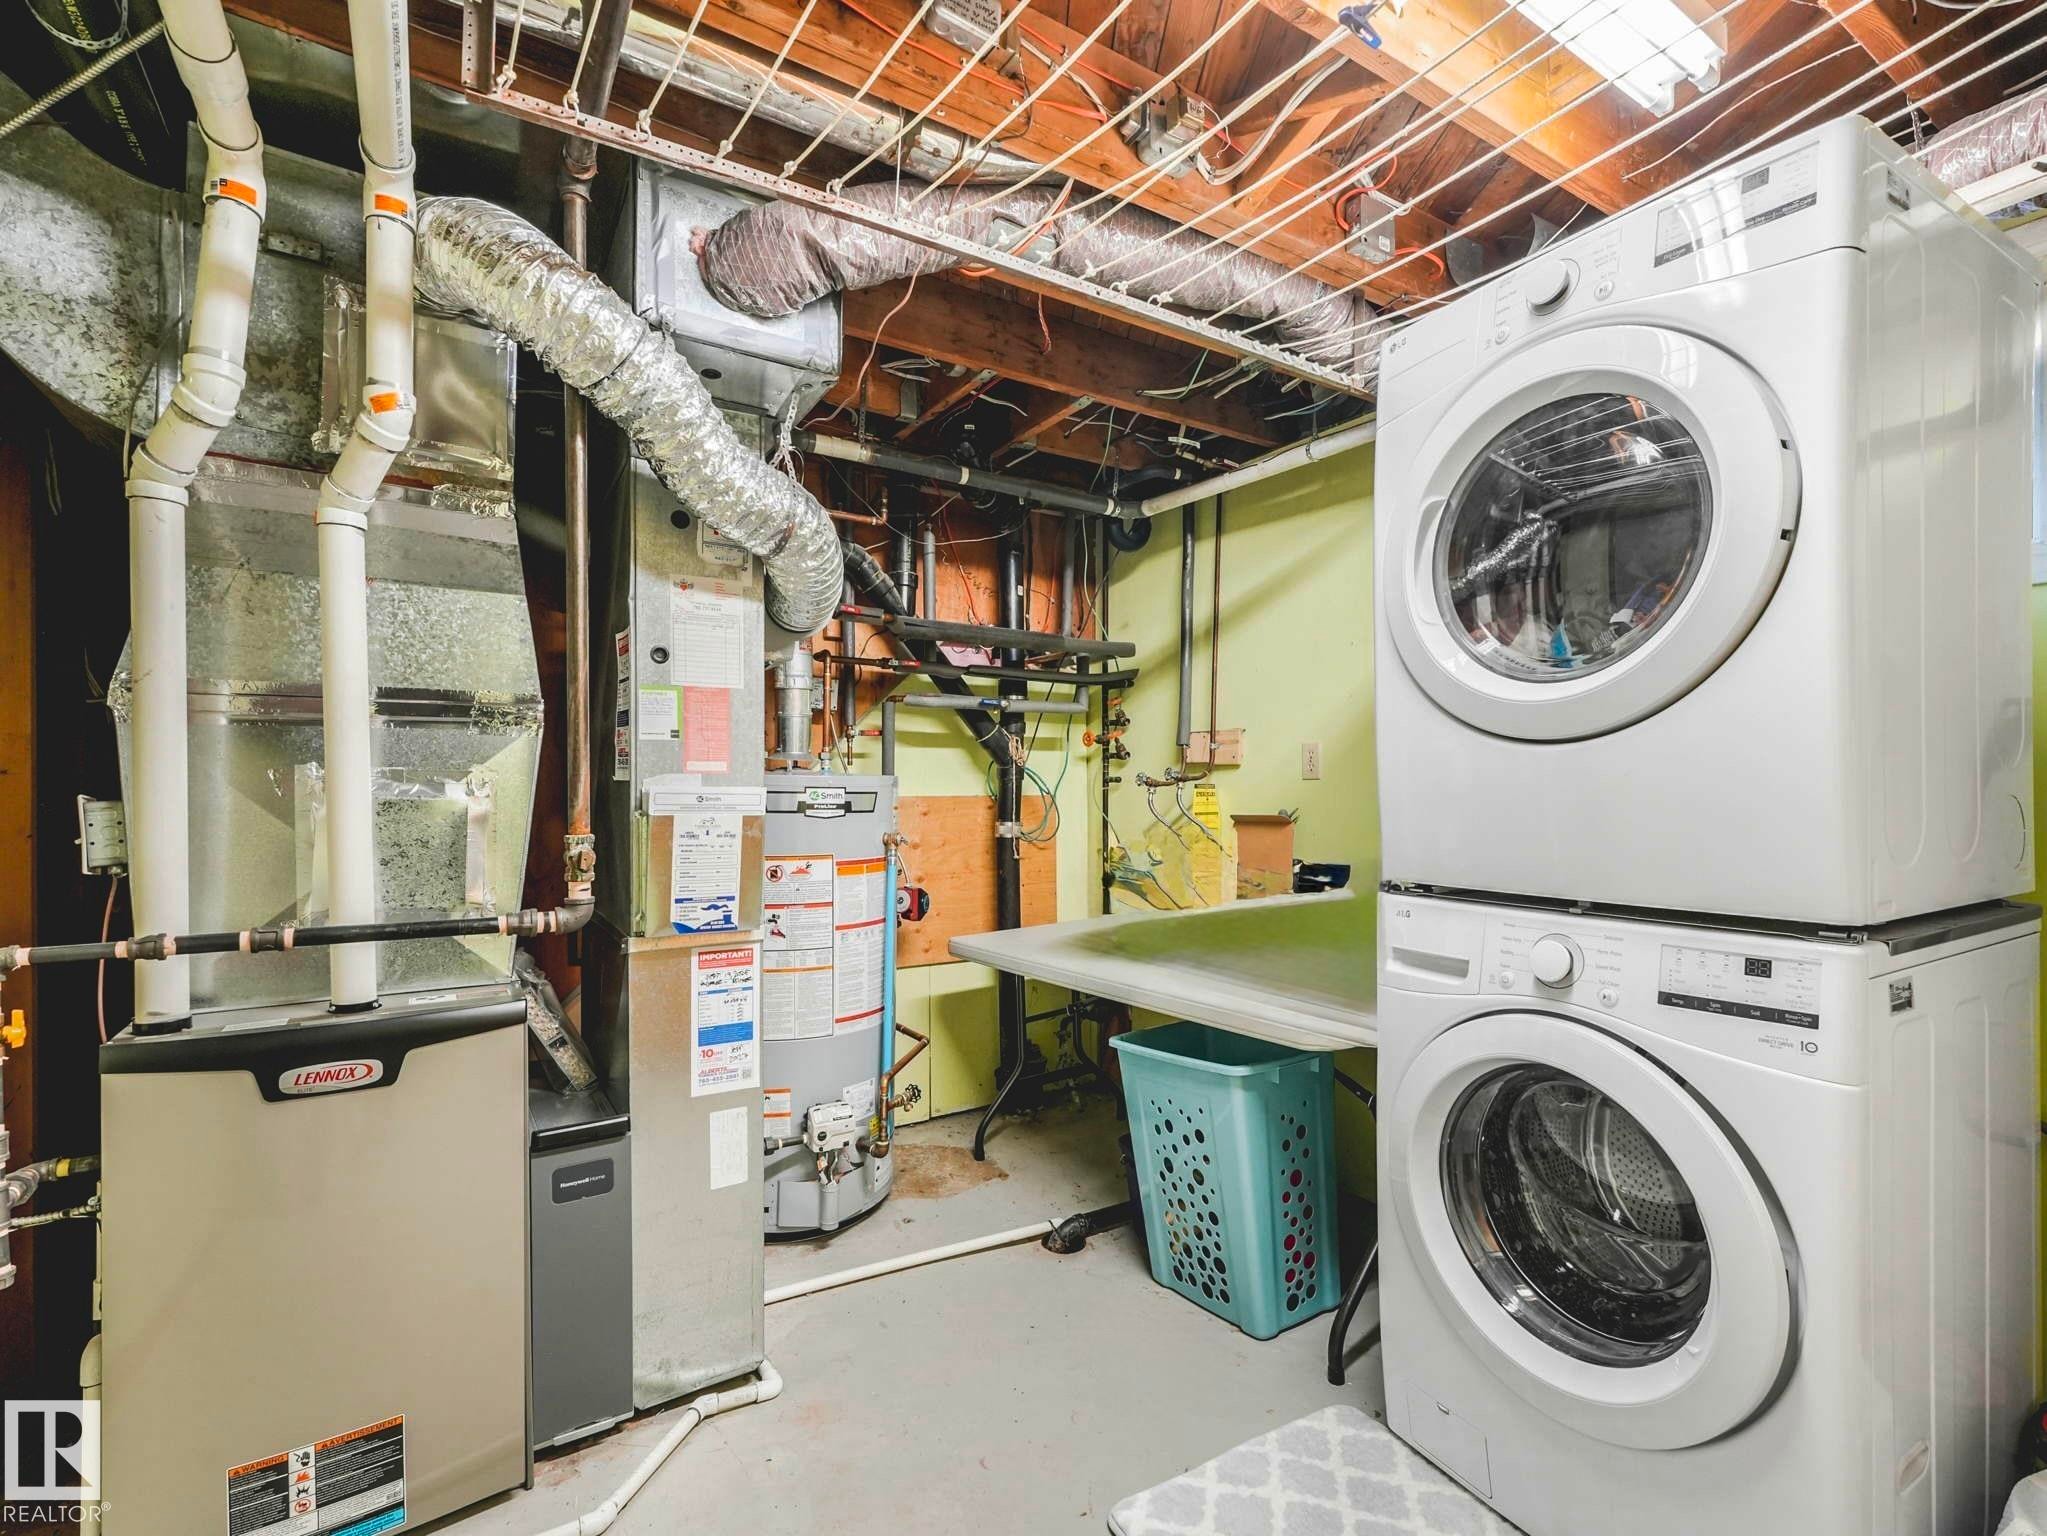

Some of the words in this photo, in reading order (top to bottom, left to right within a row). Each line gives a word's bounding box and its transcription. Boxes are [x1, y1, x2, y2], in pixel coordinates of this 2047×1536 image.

[821, 791, 843, 800] Smith
[699, 951, 753, 961] IMPORTANT!
[699, 1049, 714, 1058] 10
[1800, 1041, 1819, 1053] 10
[294, 1066, 358, 1086] LENNOX
[560, 1177, 589, 1188] Honeywell
[589, 1174, 606, 1183] Home
[327, 1418, 399, 1446] AVERTISSEMENT
[241, 1456, 286, 1473] WARNING
